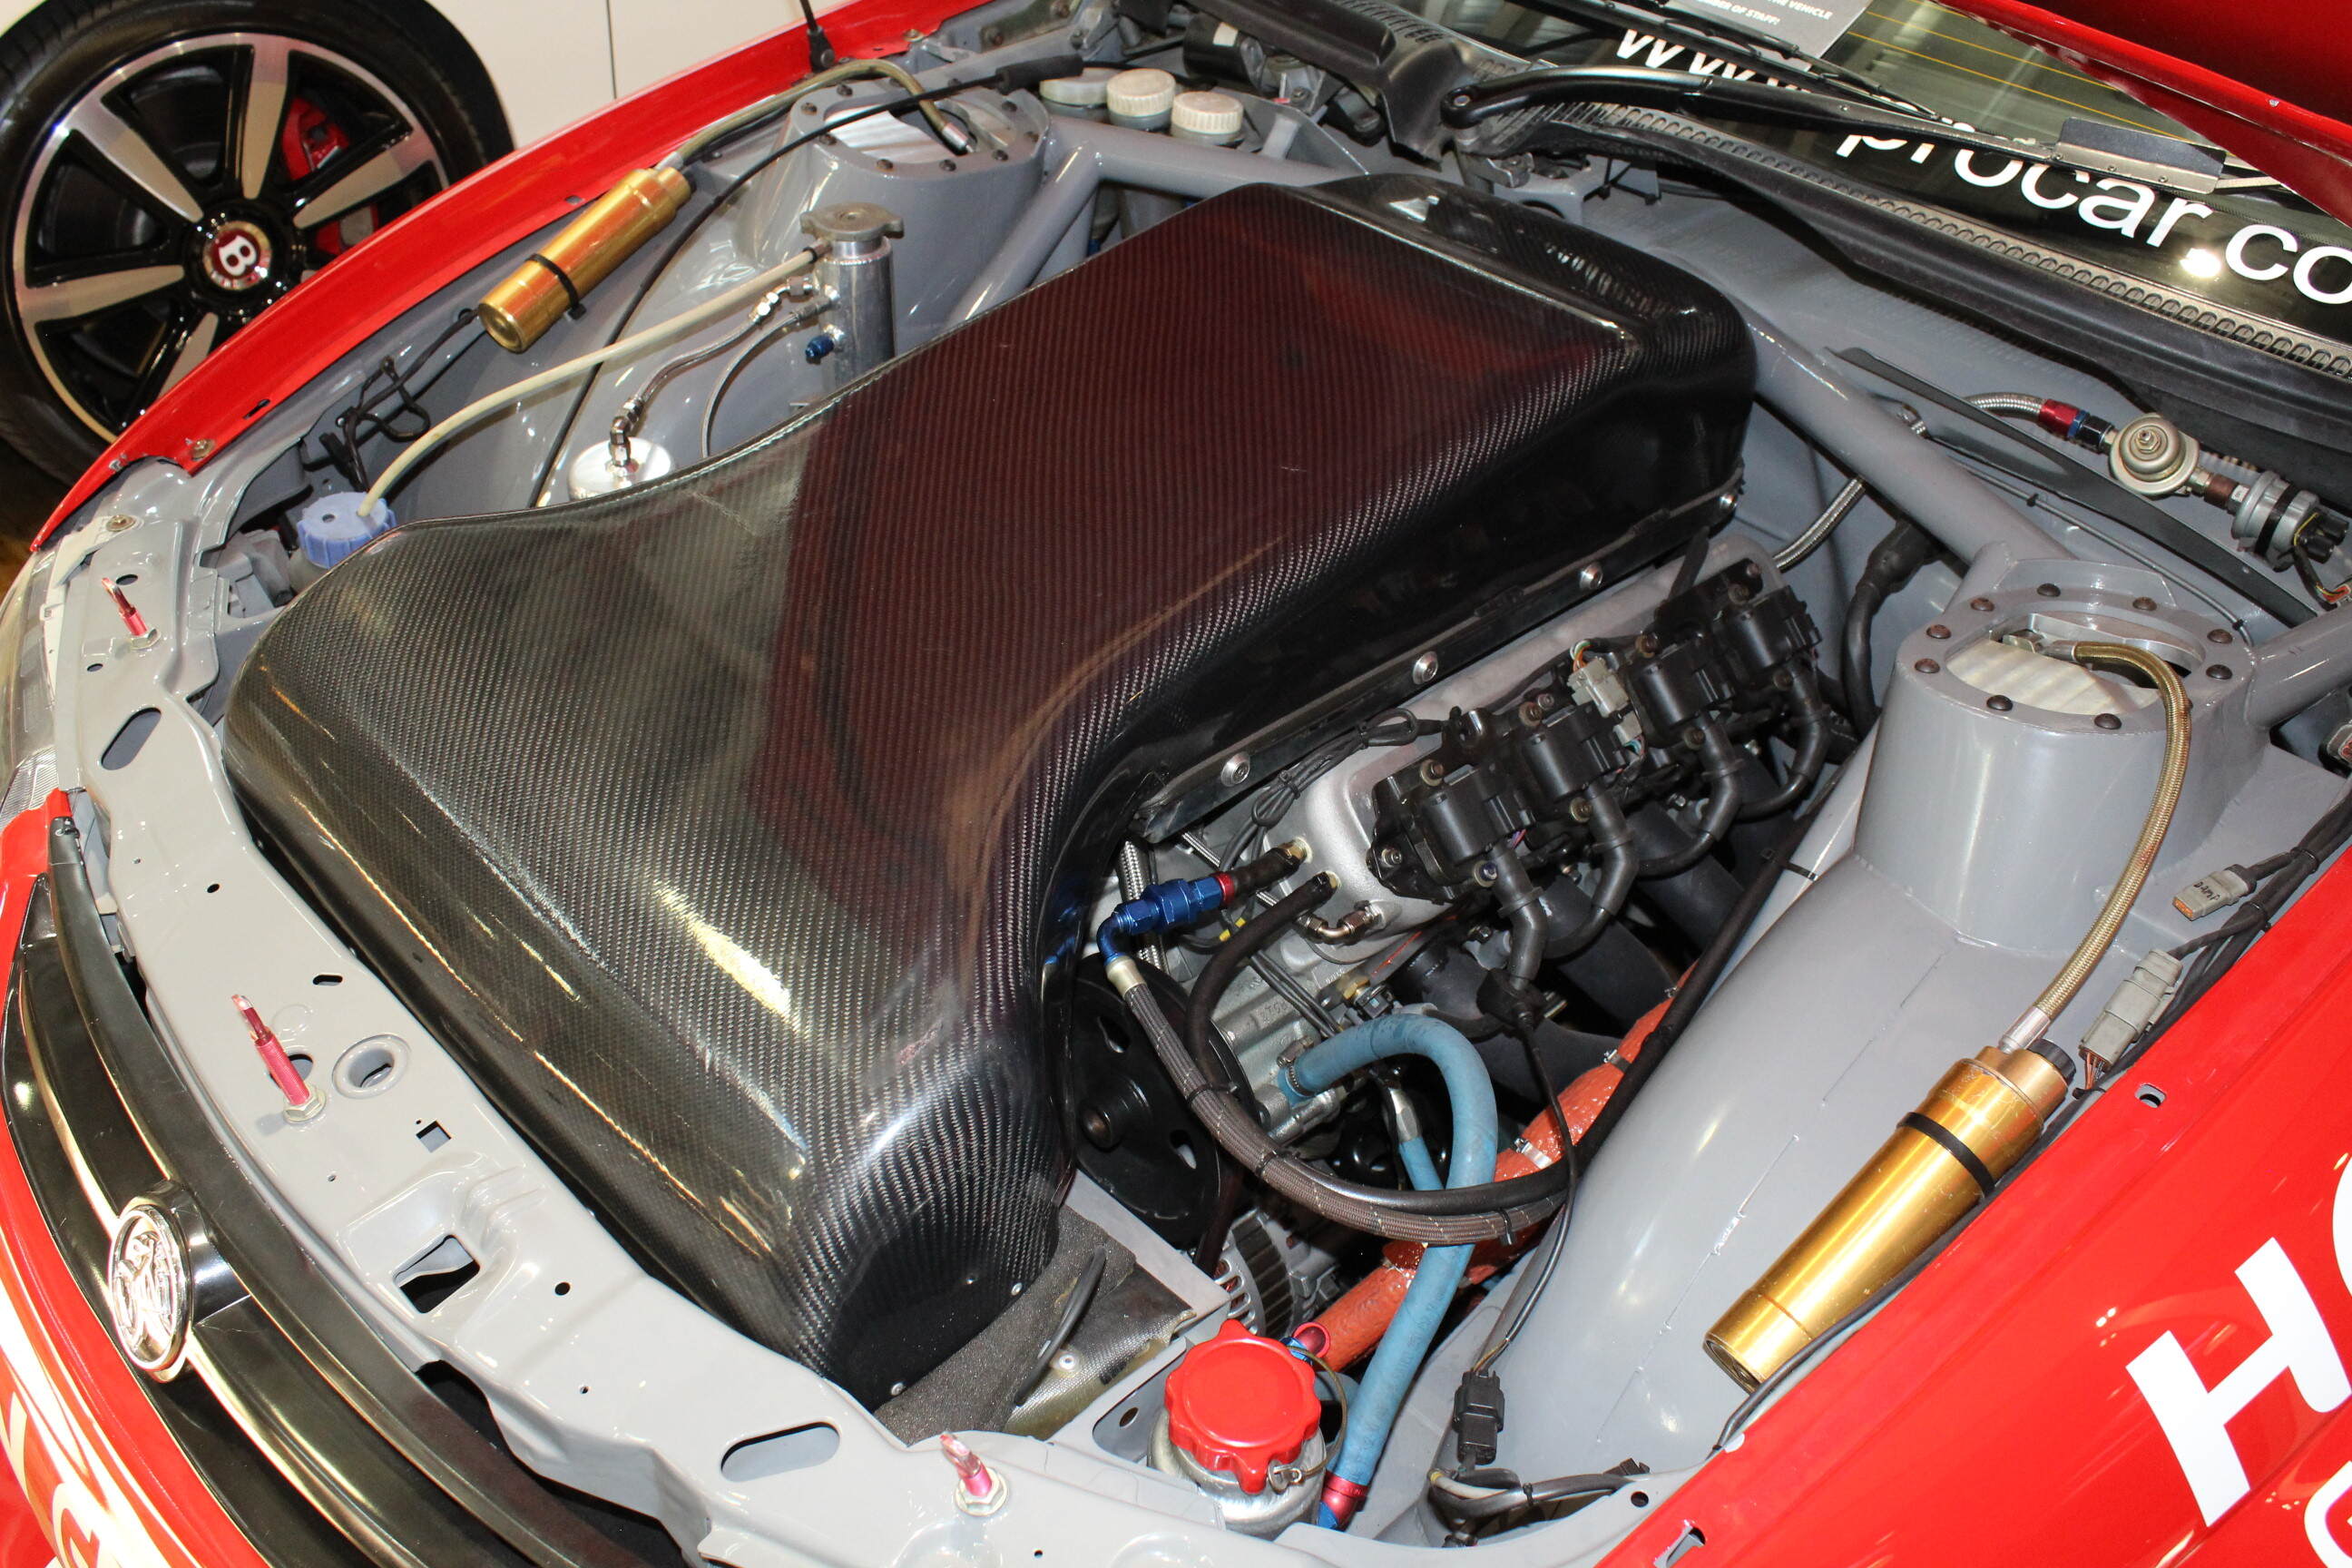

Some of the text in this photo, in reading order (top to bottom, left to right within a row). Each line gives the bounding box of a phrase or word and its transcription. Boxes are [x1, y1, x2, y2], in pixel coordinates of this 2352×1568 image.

[1730, 5, 1747, 15] OF
[1746, 9, 1781, 25] STAFF!
[1788, 0, 1833, 20] VEHICLE
[219, 235, 257, 276] B
[2125, 1154, 2352, 1527] H
